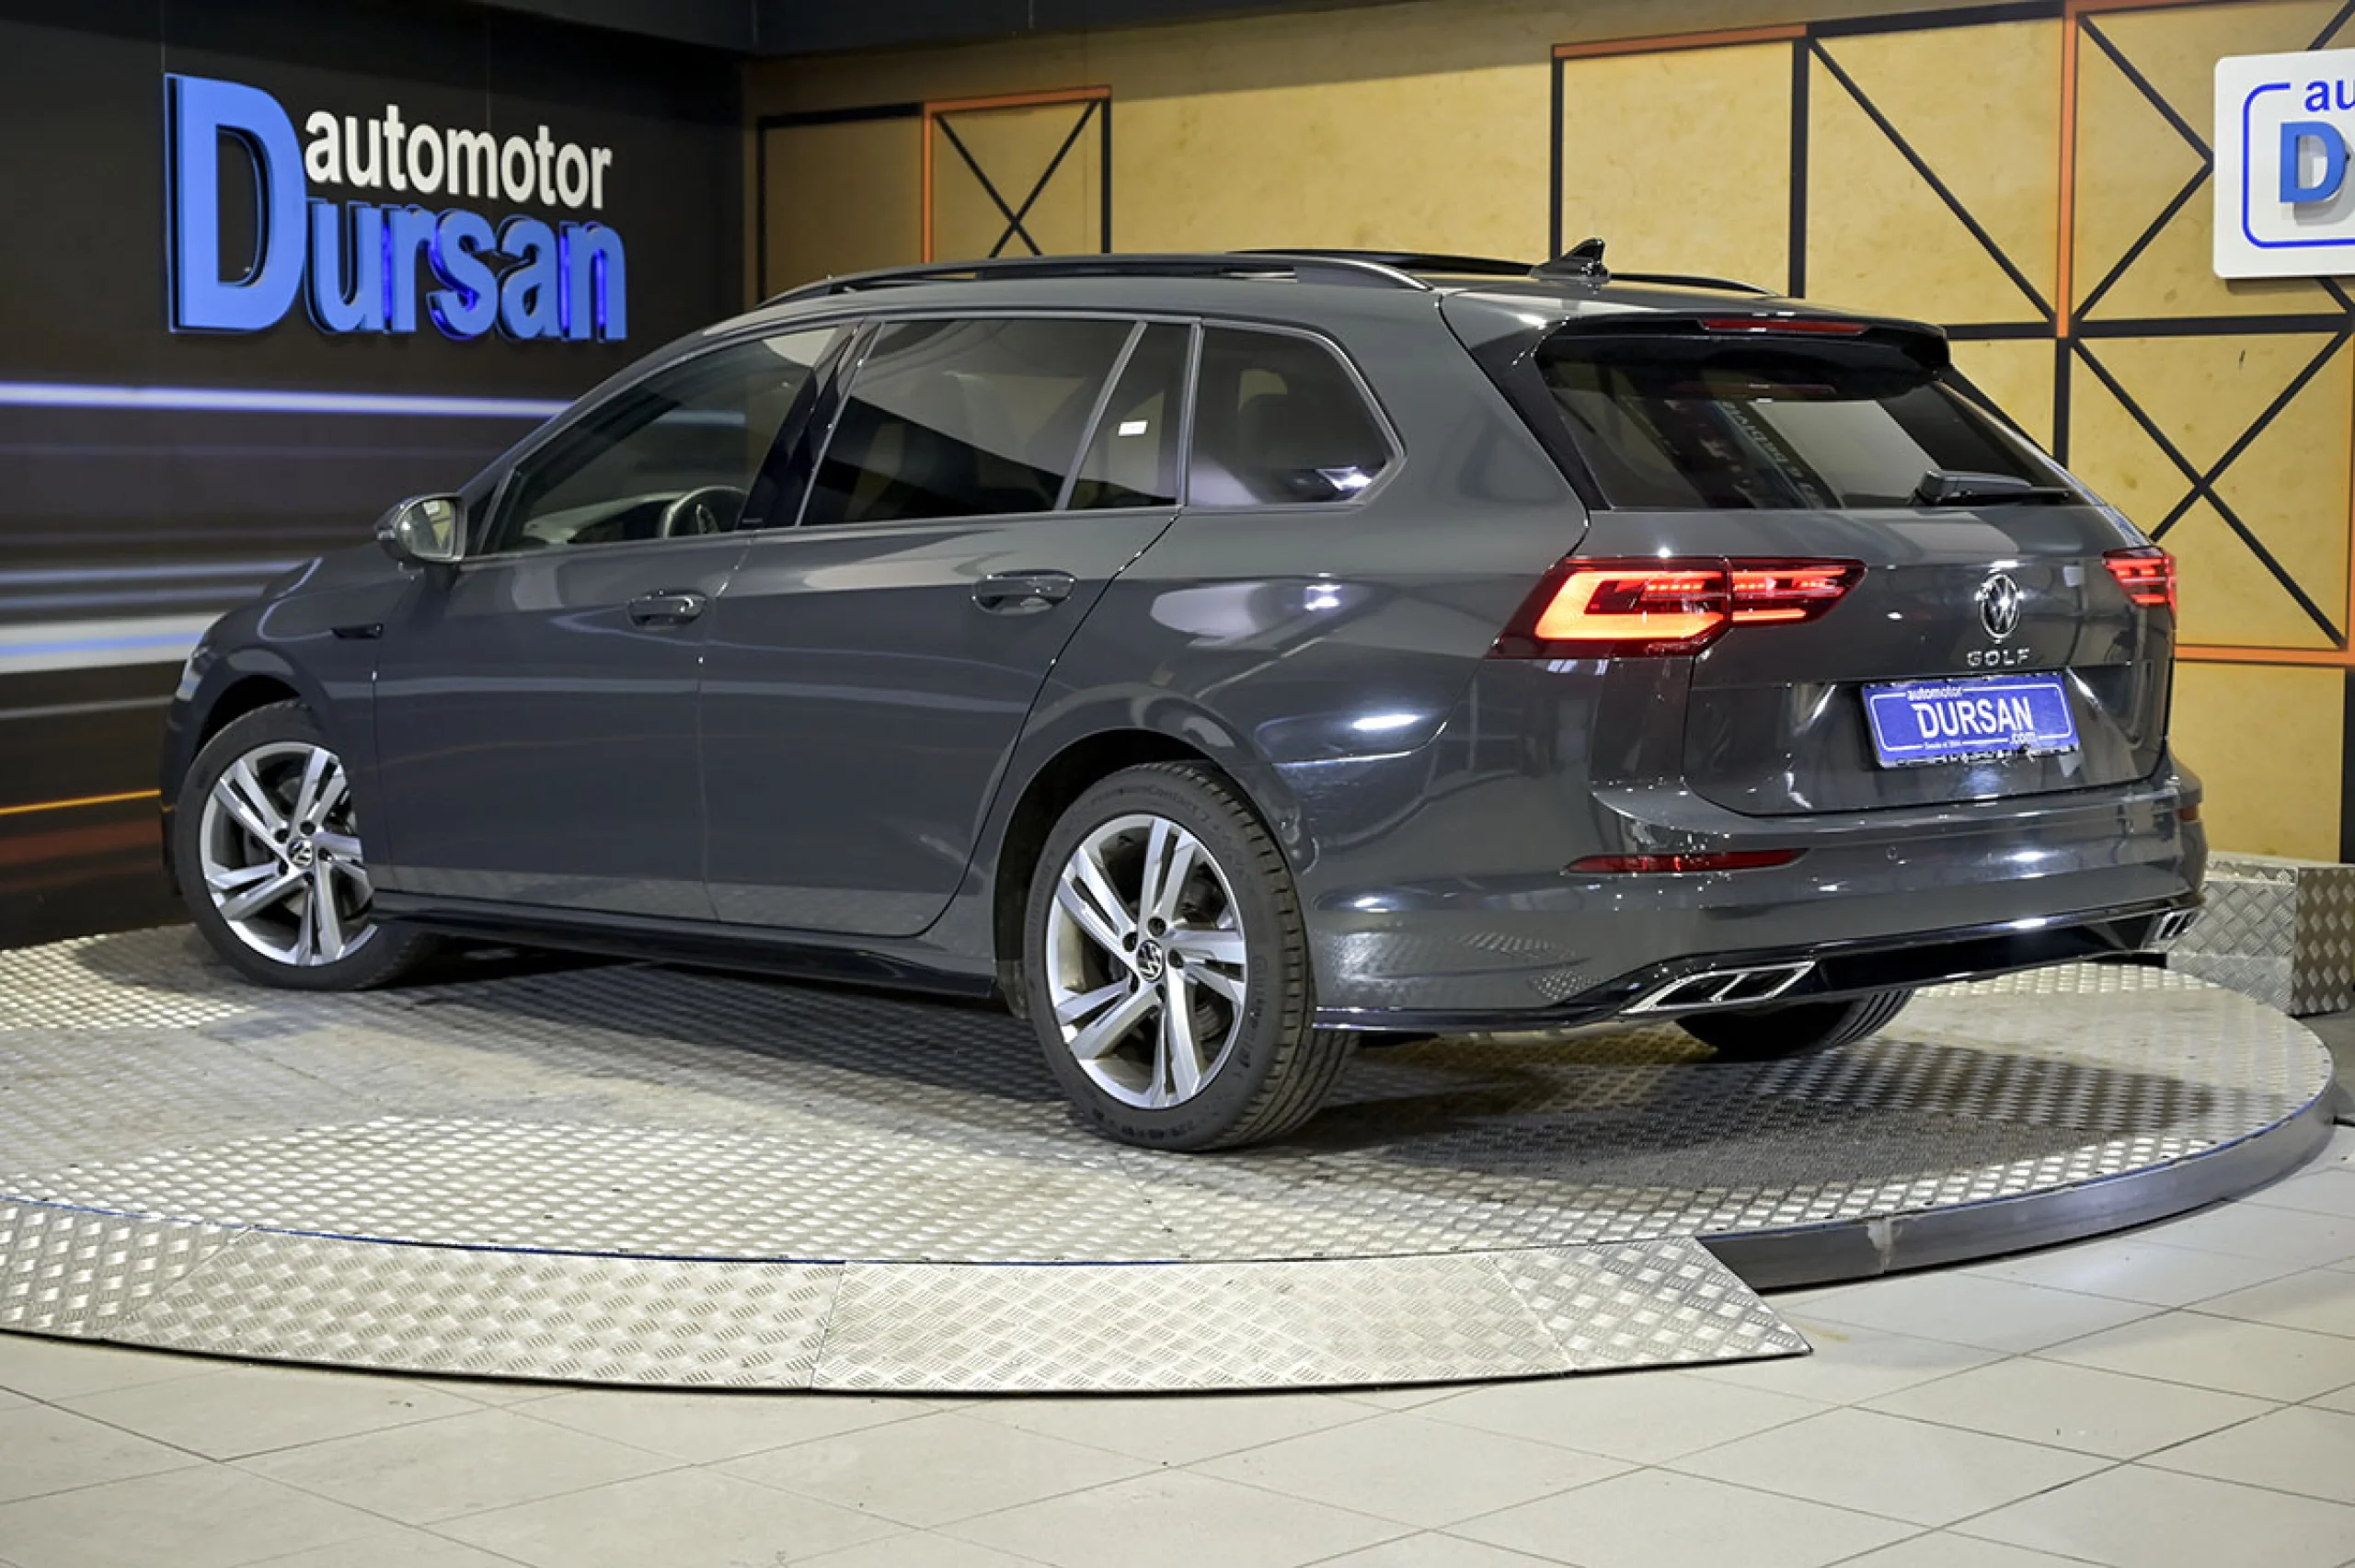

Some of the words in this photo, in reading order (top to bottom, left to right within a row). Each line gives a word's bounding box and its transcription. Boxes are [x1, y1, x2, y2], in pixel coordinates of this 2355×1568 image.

[304, 104, 614, 210] automotor
[164, 72, 627, 342] Dursan
[1966, 647, 2030, 667] GOLF
[1911, 696, 2035, 738] DURSAN
